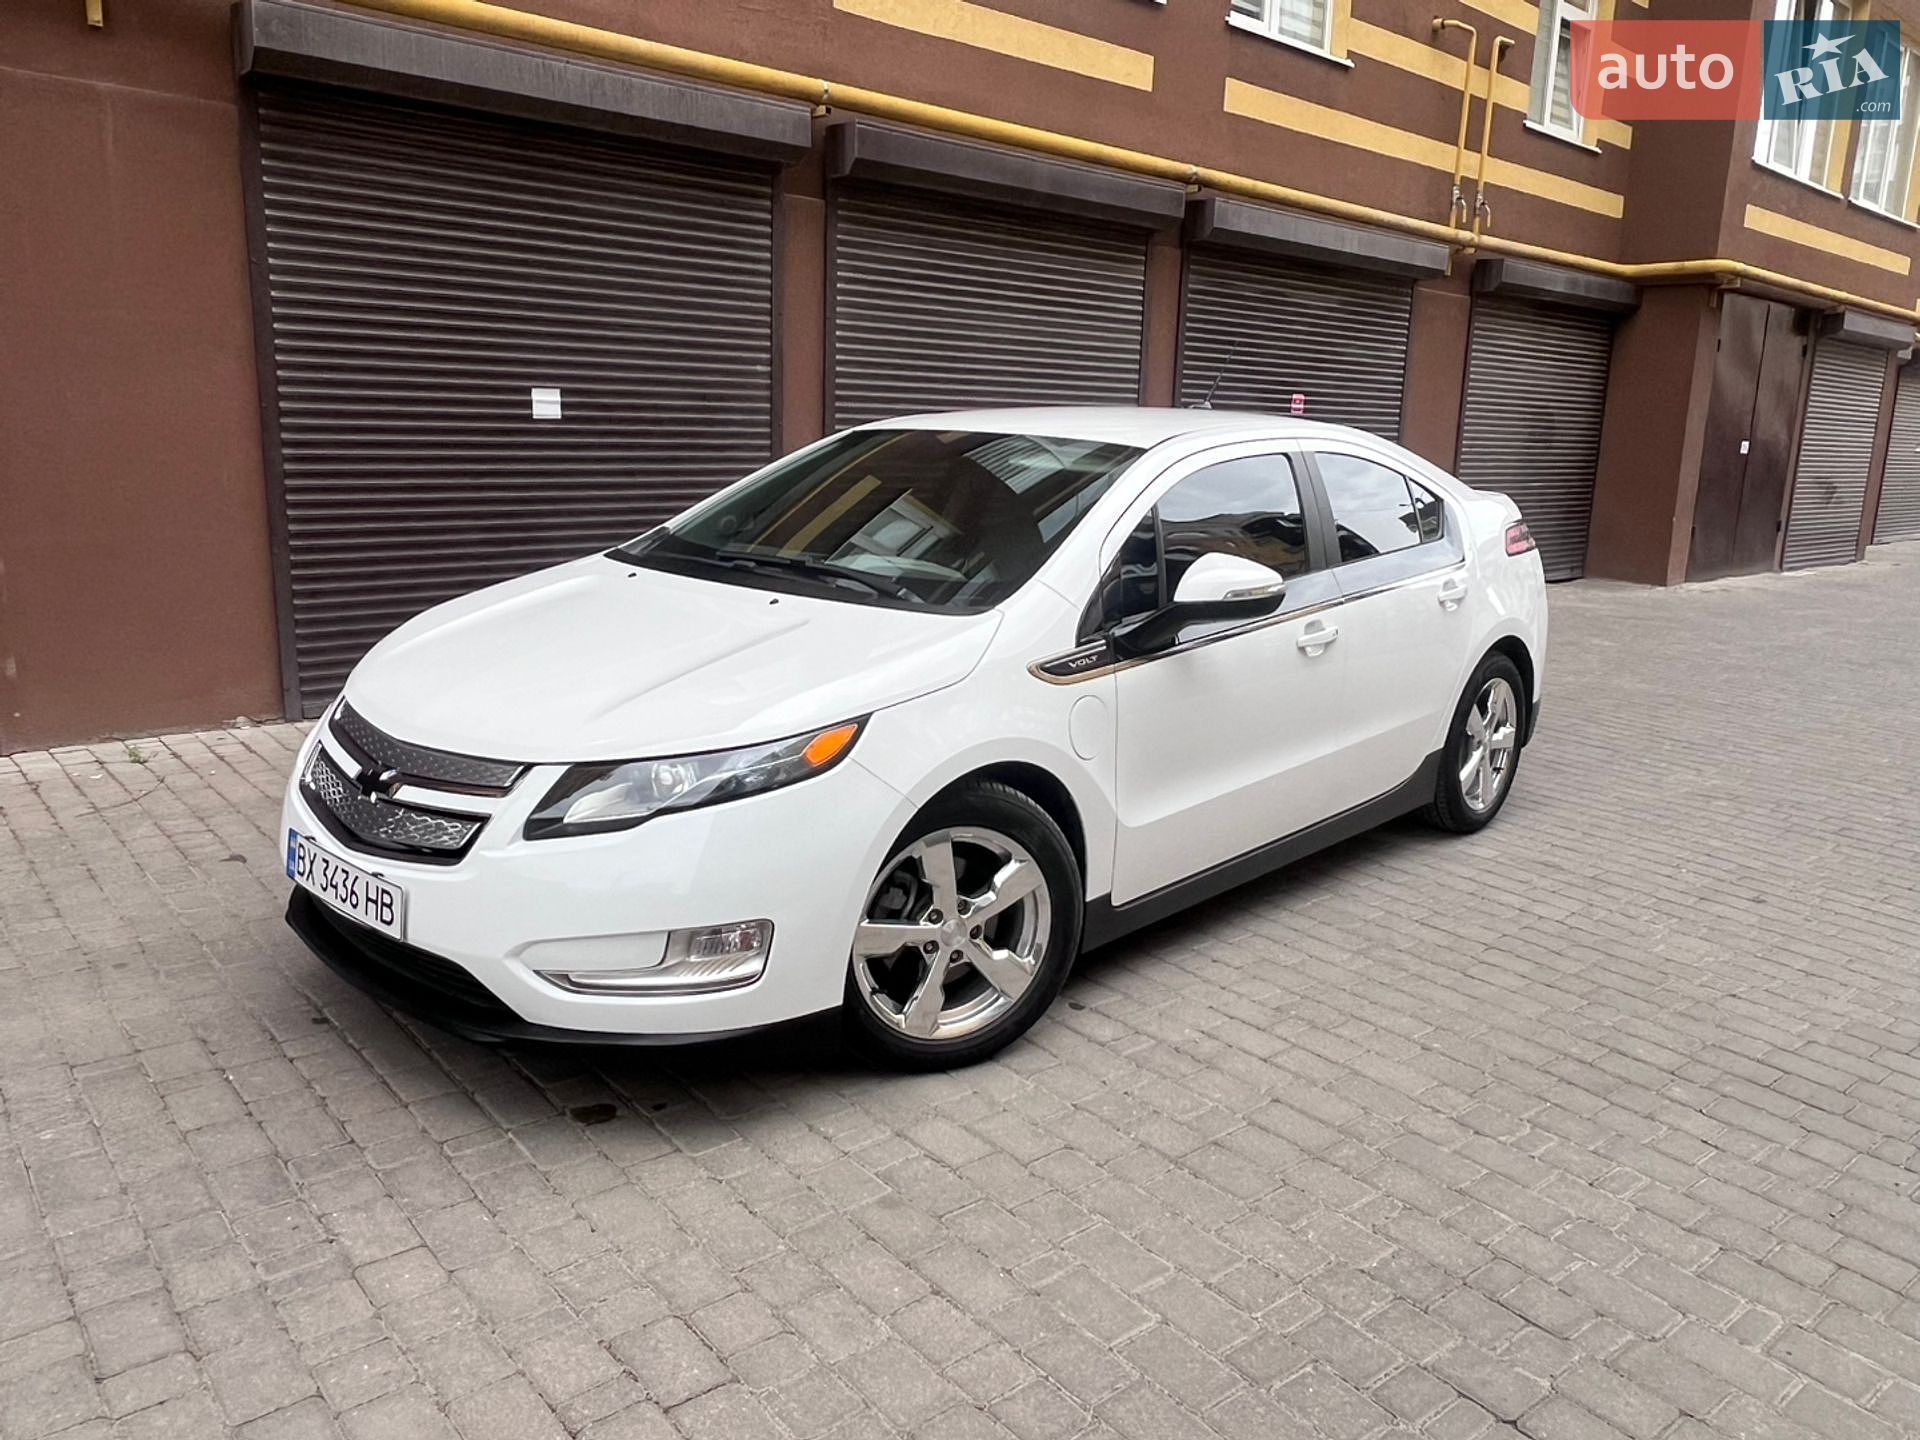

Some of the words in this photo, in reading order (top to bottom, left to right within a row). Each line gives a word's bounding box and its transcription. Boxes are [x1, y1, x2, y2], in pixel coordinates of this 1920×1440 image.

[1068, 655, 1098, 668] VOLT
[297, 842, 317, 886] BX
[320, 858, 359, 910] 3436
[365, 881, 395, 926] HB
